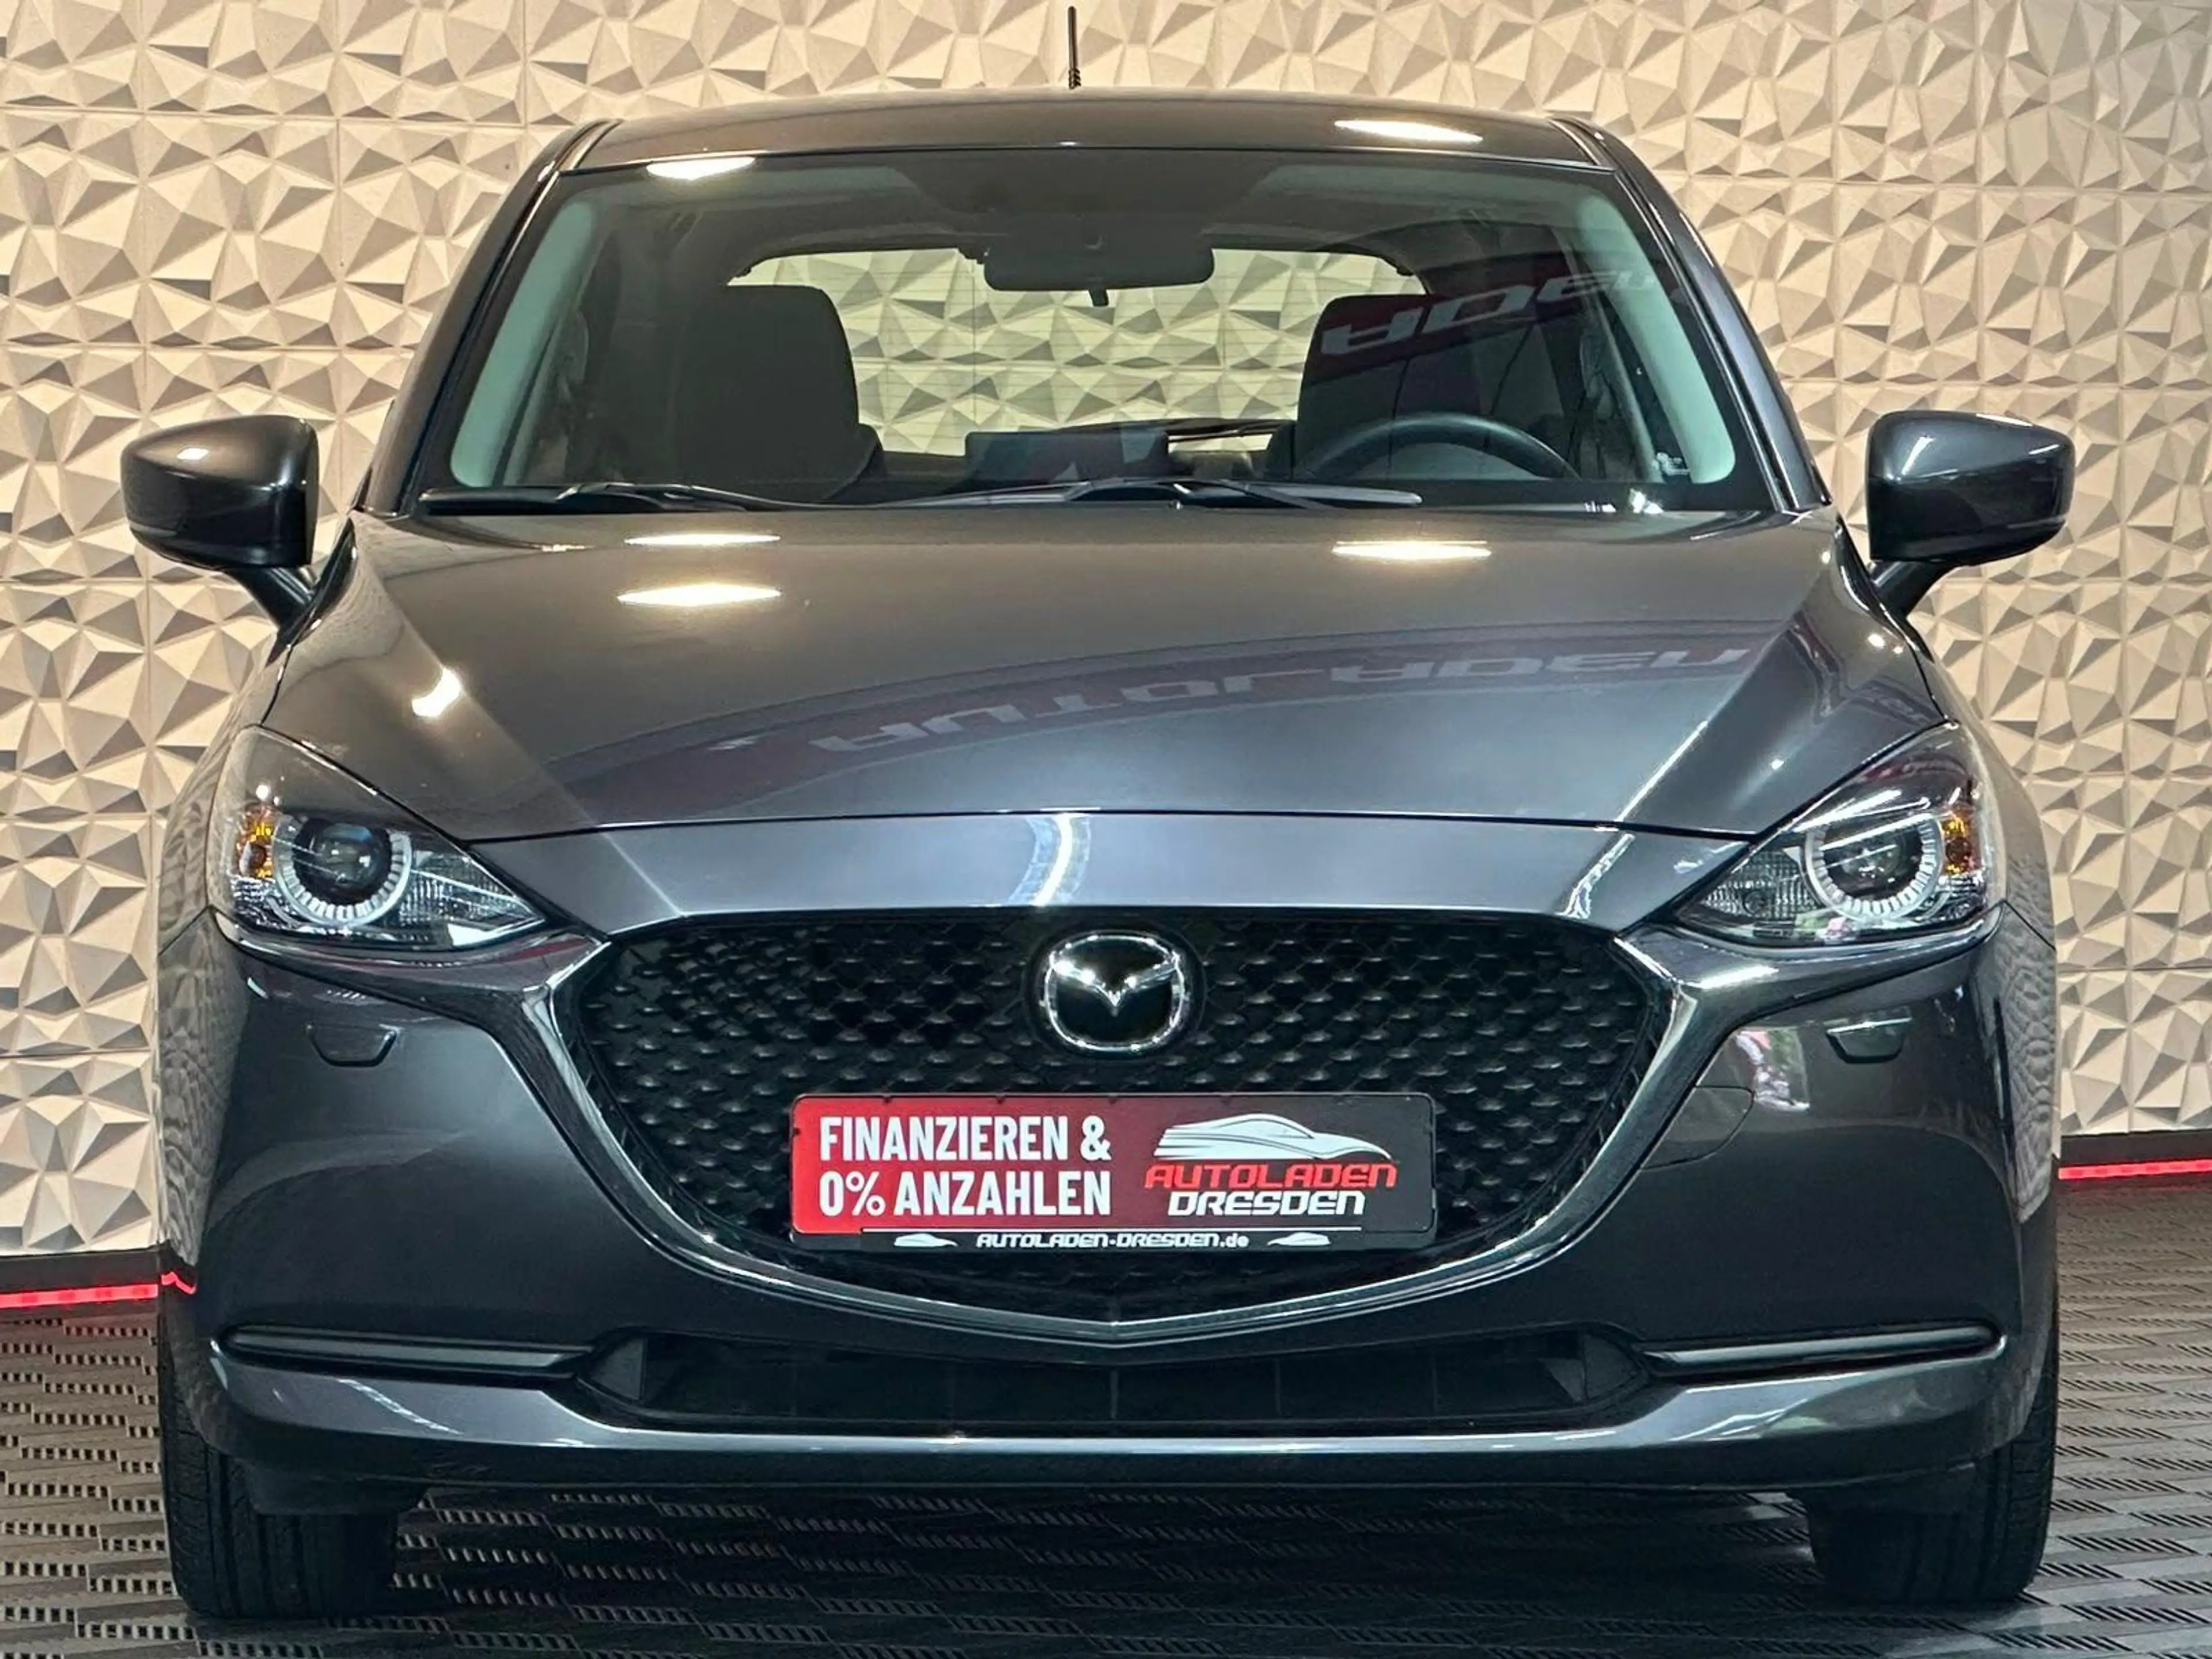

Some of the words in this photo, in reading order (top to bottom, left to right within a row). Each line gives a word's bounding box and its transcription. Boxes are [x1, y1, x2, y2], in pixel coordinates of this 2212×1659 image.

[820, 1116, 1068, 1161] FINANZIEREN
[1080, 1115, 1112, 1161] &
[819, 1171, 886, 1216] 0%
[893, 1171, 1111, 1215] ANZAHLEN
[1144, 1164, 1398, 1189] AUTOLADEN
[1168, 1190, 1366, 1216] DRESDEN
